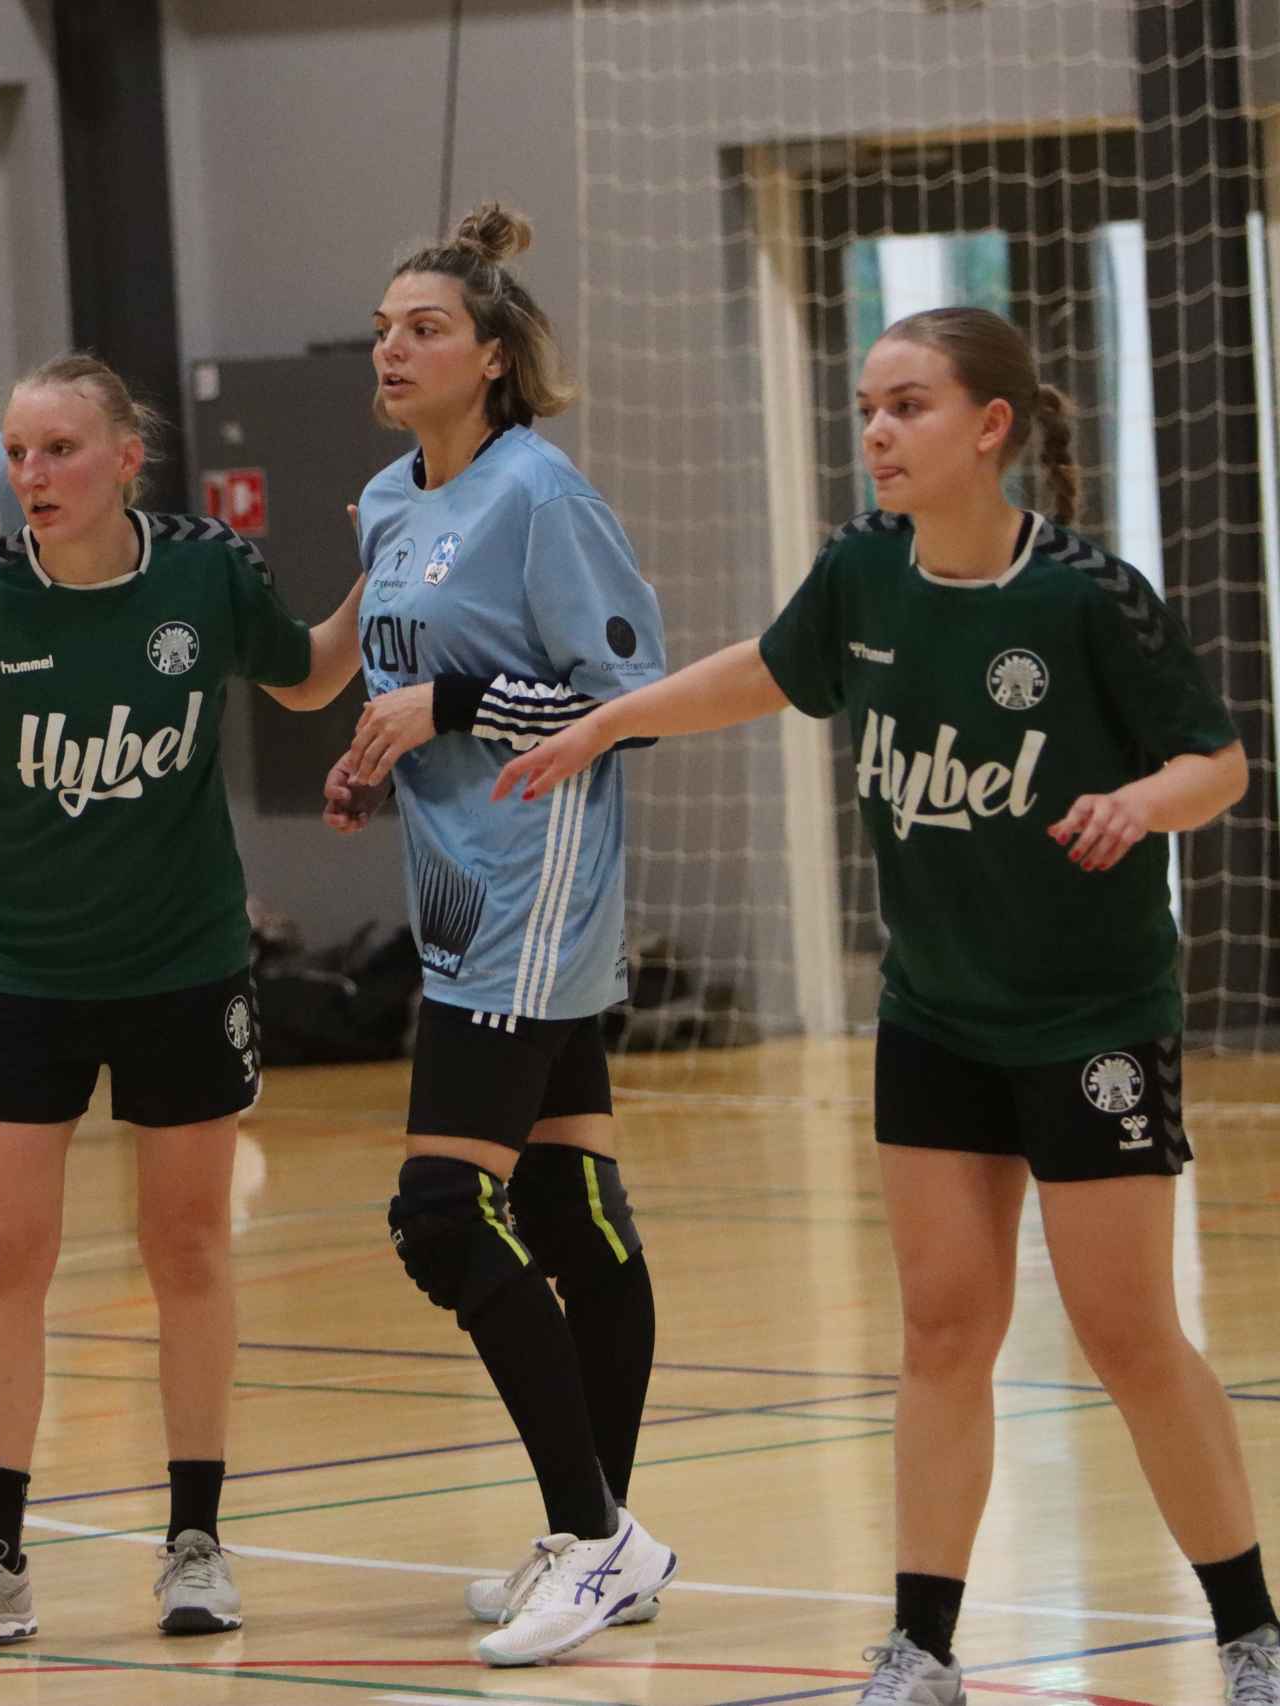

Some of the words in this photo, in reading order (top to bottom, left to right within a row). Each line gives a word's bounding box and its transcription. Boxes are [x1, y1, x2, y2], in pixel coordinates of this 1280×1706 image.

[0, 654, 53, 674] hummel
[17, 691, 203, 817] Hybel
[856, 707, 1047, 841] Hybel
